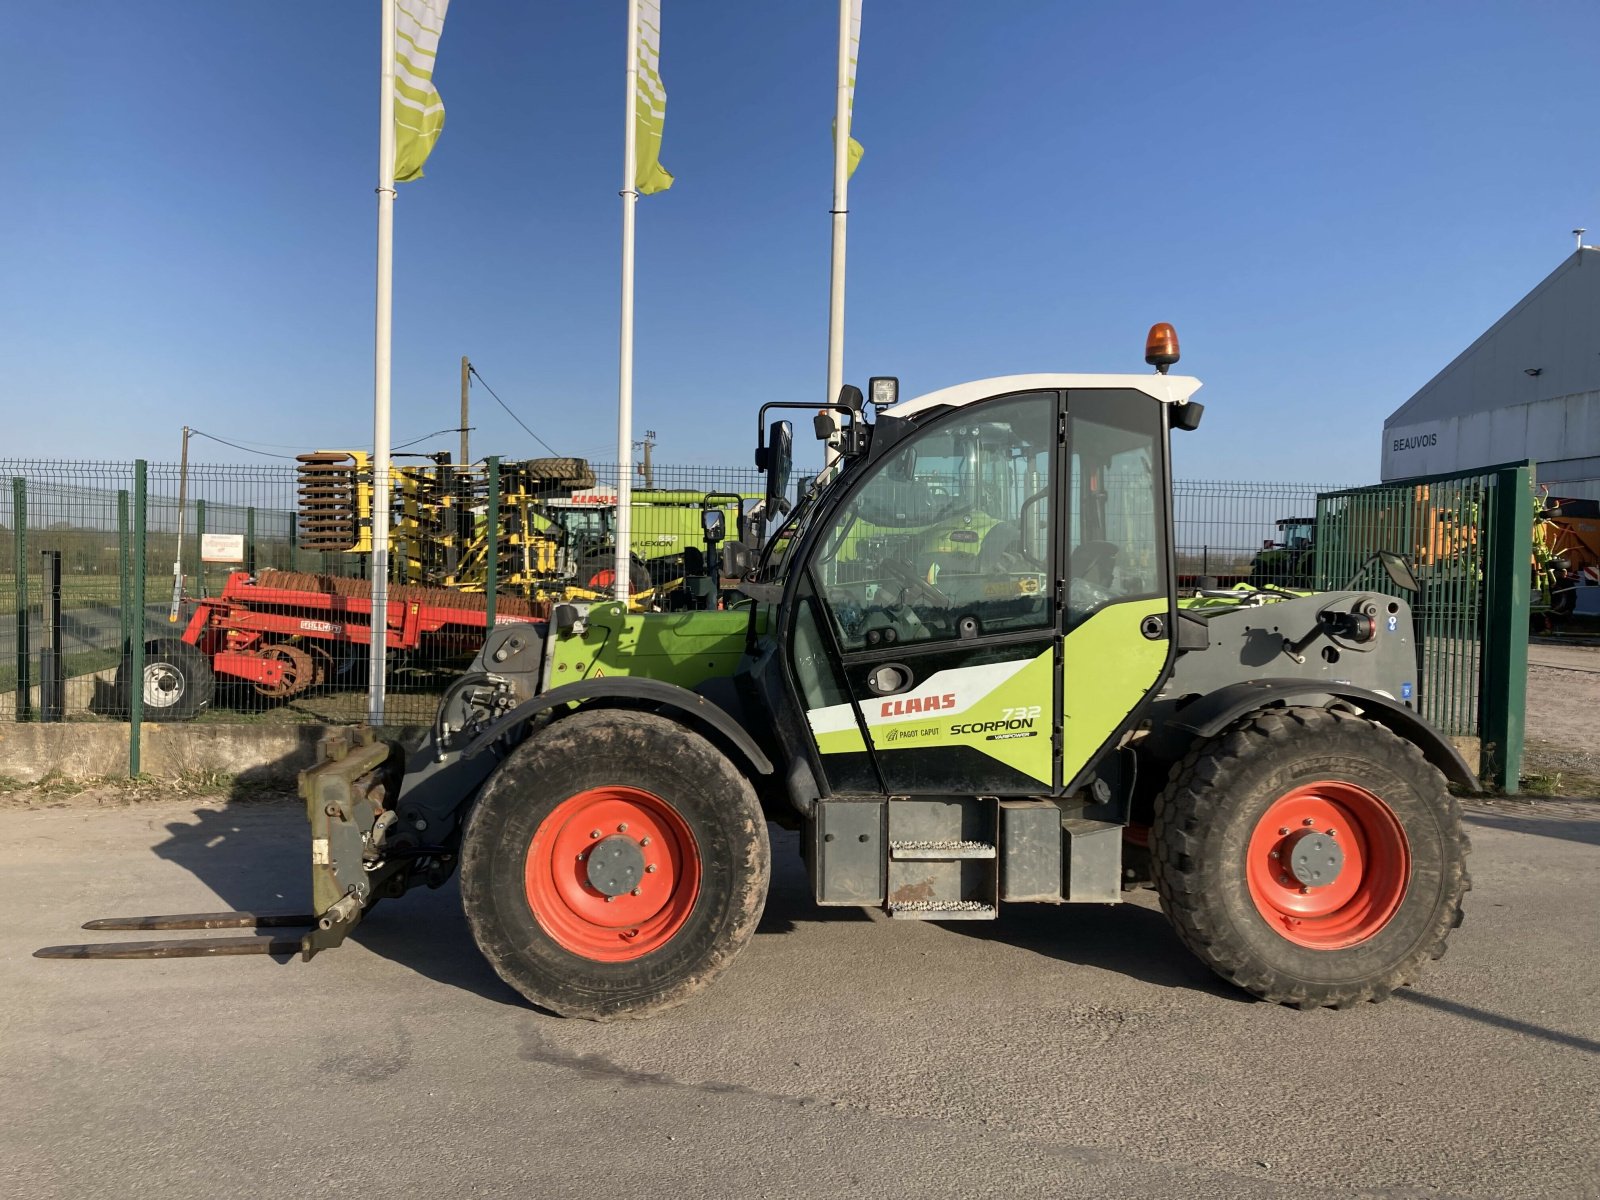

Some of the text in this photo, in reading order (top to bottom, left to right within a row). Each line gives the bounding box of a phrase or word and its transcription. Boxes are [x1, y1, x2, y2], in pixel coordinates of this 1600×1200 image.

[1393, 433, 1437, 451] BEAUVOIS
[880, 693, 956, 717] CLAAS
[1001, 705, 1042, 721] 732
[899, 727, 940, 739] PAGOT CAPUT
[950, 717, 1034, 735] SCORPION
